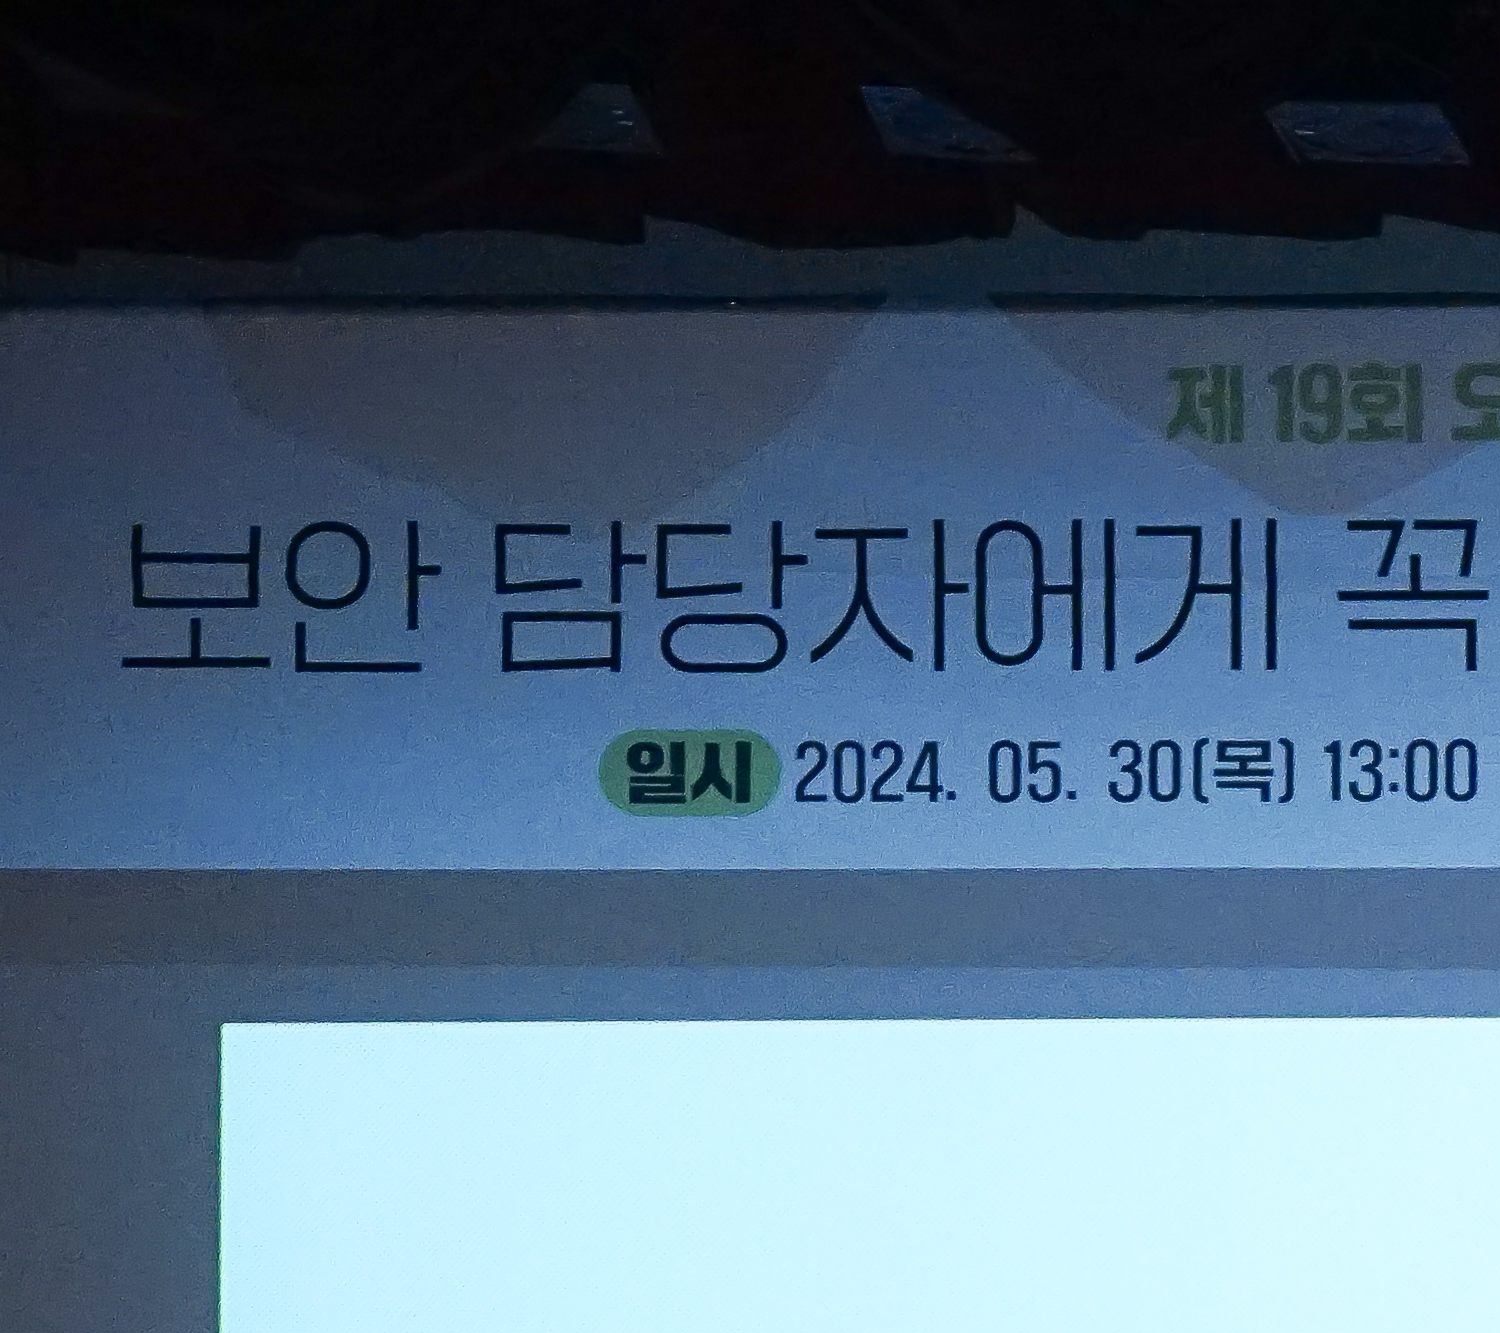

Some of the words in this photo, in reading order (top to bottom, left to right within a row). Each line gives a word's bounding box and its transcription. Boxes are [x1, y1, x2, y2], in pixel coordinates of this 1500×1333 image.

[1166, 364, 1244, 443] 제
[1268, 363, 1423, 444] 19회
[121, 521, 441, 672] 보안
[494, 519, 1277, 673] 담당자에게
[1337, 519, 1489, 671] 꼭
[627, 741, 751, 804] 일시
[796, 740, 956, 803] 2024.
[989, 740, 1076, 803] 05.
[1109, 738, 1294, 803] 30(목)
[1324, 739, 1477, 802] 13:00
